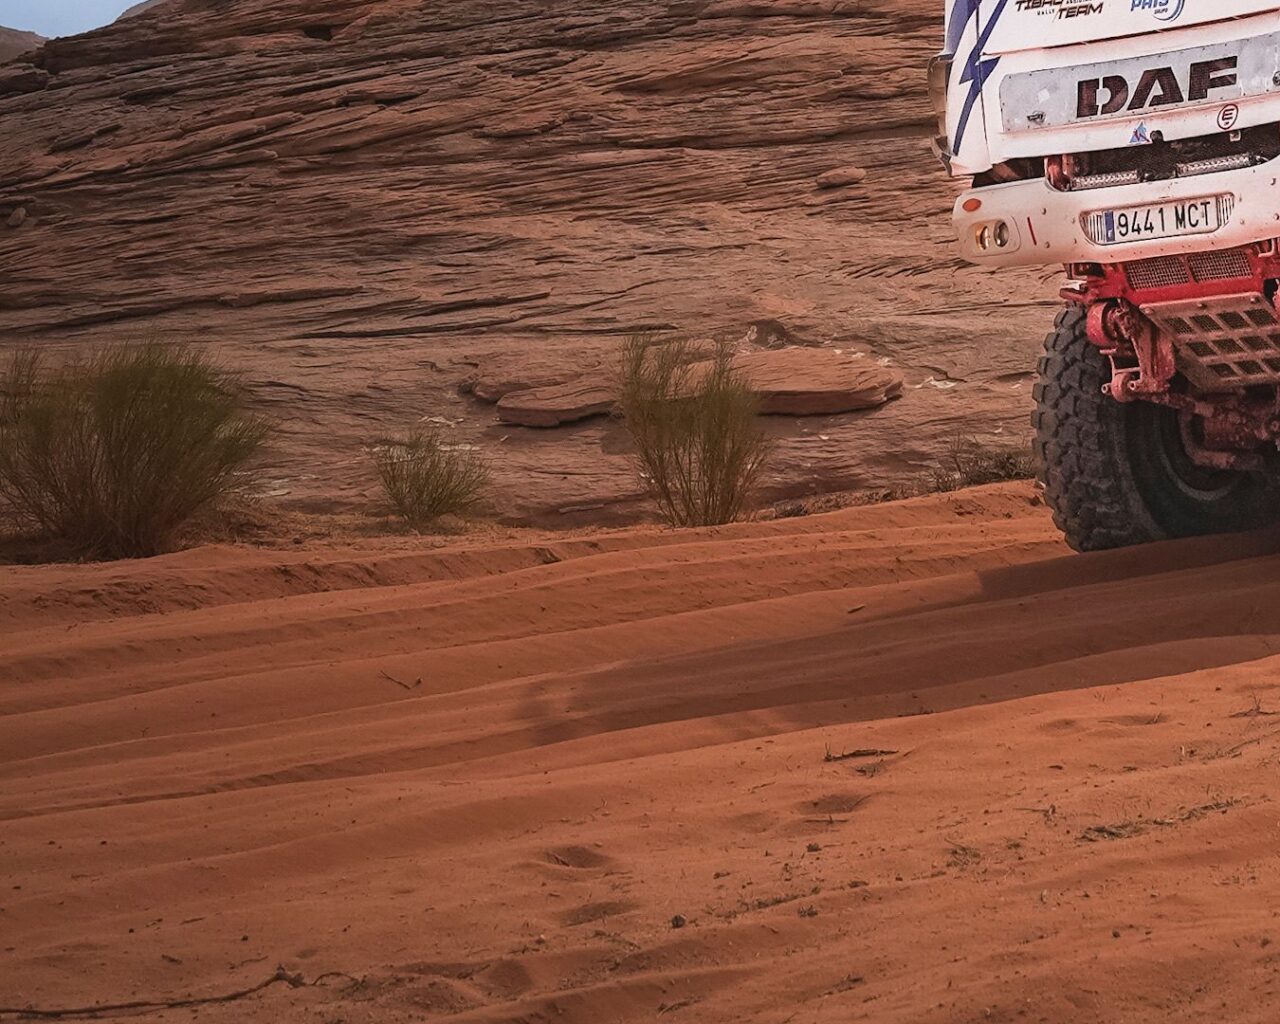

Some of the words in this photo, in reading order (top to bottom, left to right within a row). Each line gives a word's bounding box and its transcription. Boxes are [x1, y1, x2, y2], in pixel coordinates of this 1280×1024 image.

[1057, 2, 1104, 19] TEAM
[1076, 55, 1238, 118] DAF
[1117, 207, 1166, 237] 9441
[1174, 201, 1211, 230] MCT
